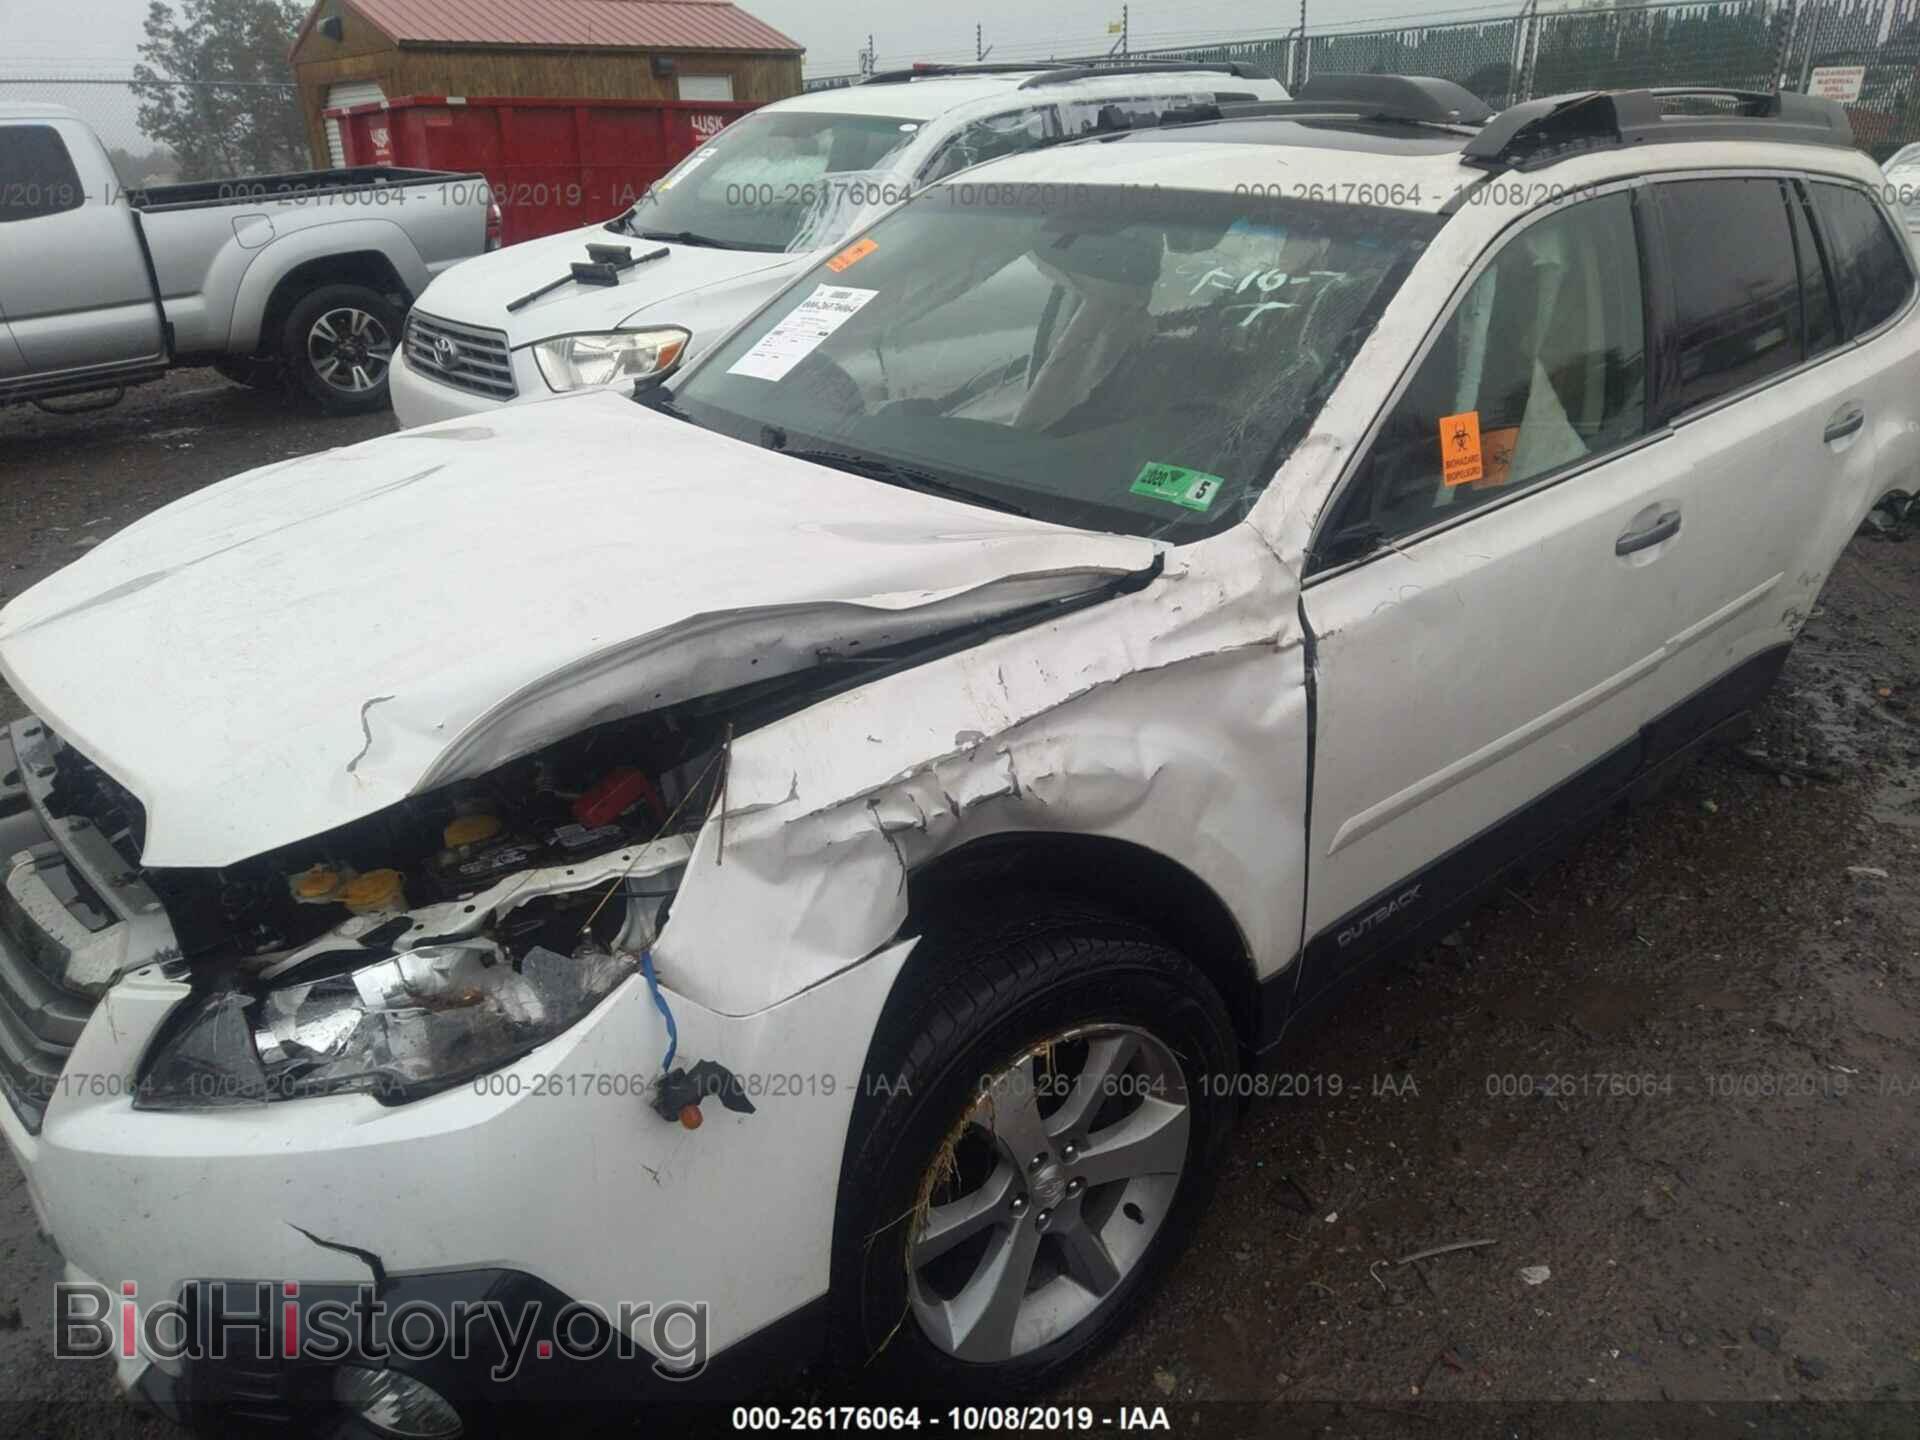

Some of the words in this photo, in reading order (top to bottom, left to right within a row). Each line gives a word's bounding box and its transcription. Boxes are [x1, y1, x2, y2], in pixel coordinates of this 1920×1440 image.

[691, 115, 724, 134] LUSK
[1195, 480, 1211, 499] 5
[1338, 884, 1422, 947] OUTBACK
